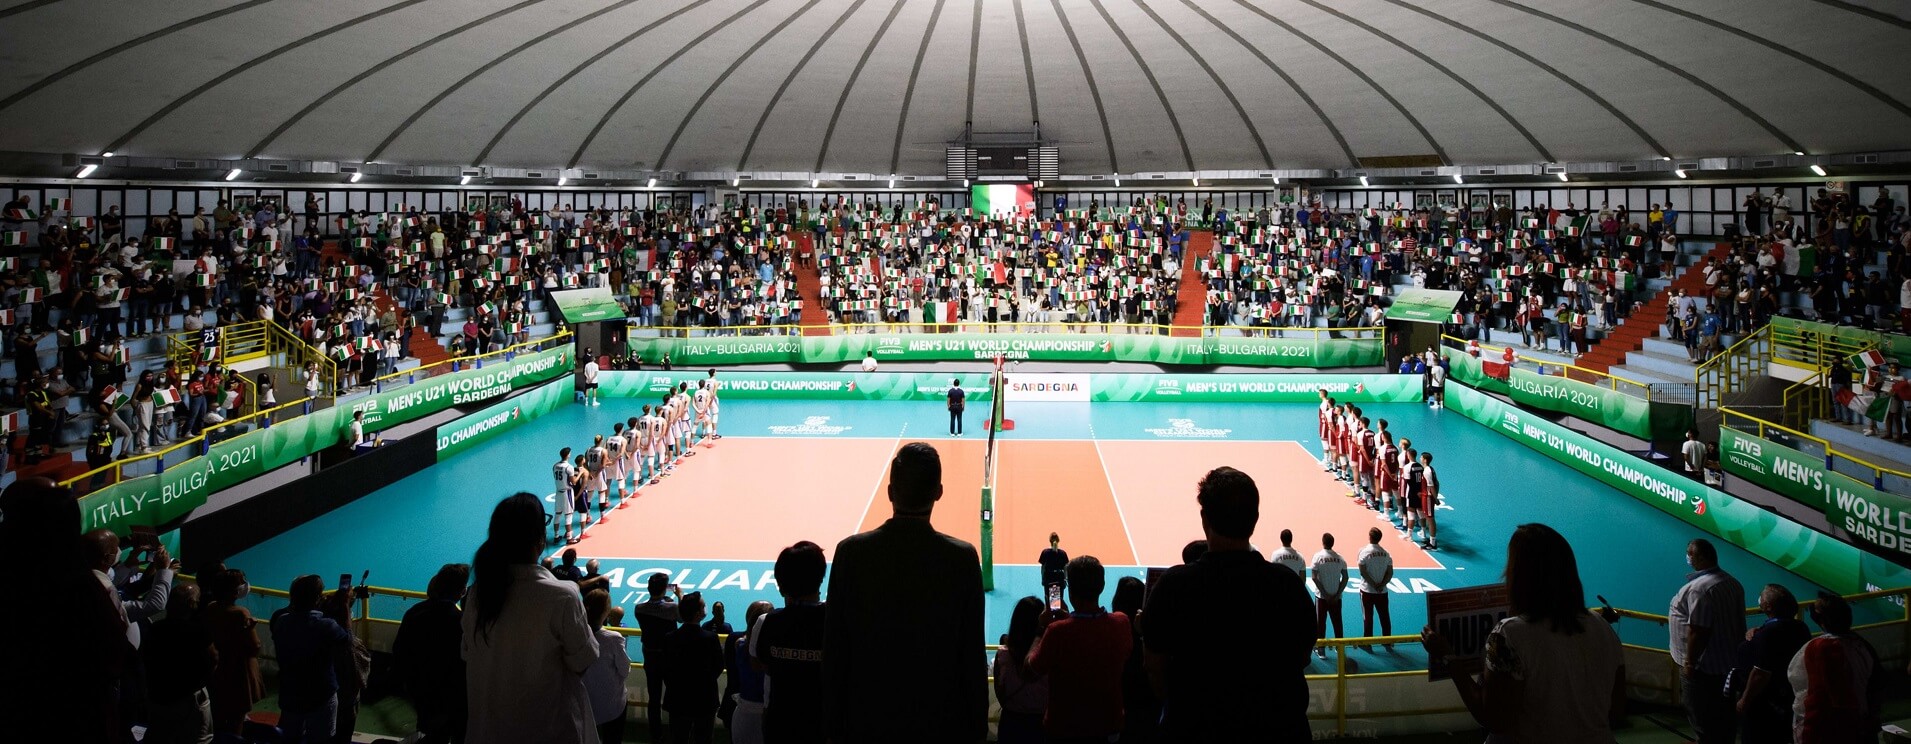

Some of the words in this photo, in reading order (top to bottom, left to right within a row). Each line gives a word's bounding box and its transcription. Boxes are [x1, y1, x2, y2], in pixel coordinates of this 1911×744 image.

[204, 332, 215, 343] 23
[880, 338, 901, 346] FIVB
[777, 342, 801, 354] 2021
[909, 340, 943, 351] MEN'S
[945, 340, 965, 351] U21
[967, 340, 1010, 351] WORLD
[1011, 340, 1095, 352] CHAMPIONSHIP
[1281, 345, 1310, 357] 2021
[731, 380, 769, 391] WORLD
[771, 380, 842, 391] CHAMPIONSHIP
[1012, 382, 1079, 392] SARDEGNA
[1158, 379, 1179, 387] FIVB
[1186, 382, 1218, 393] MEN'S
[1219, 382, 1237, 393] U21
[1238, 382, 1275, 393] WORLD
[1276, 382, 1349, 394] CHAMPIONSHIP
[387, 389, 423, 415] MEN'S
[425, 383, 446, 401] U21
[449, 373, 495, 396] WORLD
[453, 383, 512, 405] SARDEGNA
[1570, 390, 1599, 410] 2021
[1504, 411, 1519, 424] FIVB
[451, 410, 510, 445] CHAMPIONSHIP
[640, 421, 647, 430] 11
[609, 443, 618, 452] 14
[1733, 437, 1762, 457] FIVB
[220, 444, 256, 472] 2021
[1523, 422, 1547, 443] MEN'S
[1547, 433, 1564, 452] U21
[1565, 441, 1601, 467] WORLD
[1603, 457, 1687, 505] CHAMPIONSHIP
[1729, 455, 1766, 475] VOLLEYBALL
[555, 471, 563, 481] 15
[1773, 456, 1823, 491] MEN'S
